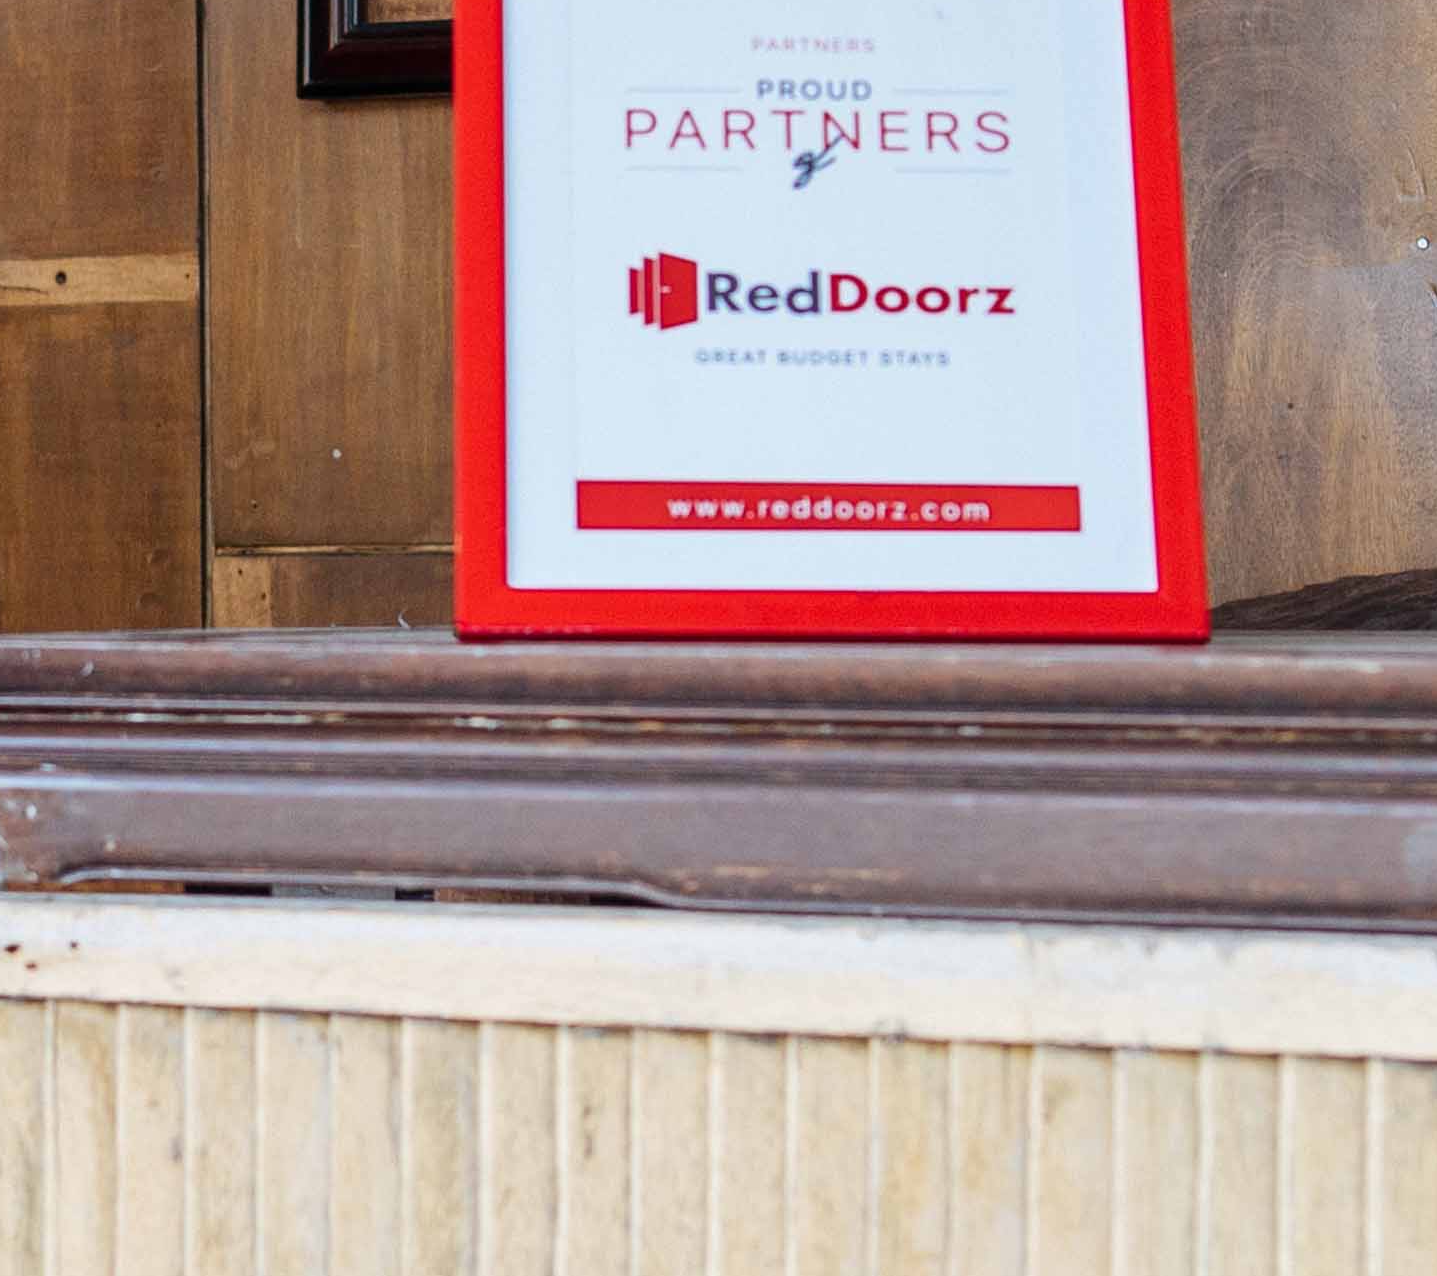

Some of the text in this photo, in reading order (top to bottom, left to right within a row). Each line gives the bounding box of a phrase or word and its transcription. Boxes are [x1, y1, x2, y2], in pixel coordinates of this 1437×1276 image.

[750, 36, 876, 54] PARTNERS
[755, 78, 873, 101] PROUD
[626, 108, 1012, 153] PARTNERS
[705, 270, 1016, 315] RedDoorz
[695, 346, 951, 367] GREAT BUDGET STAYS
[665, 493, 992, 523] www.reddoorz.com
